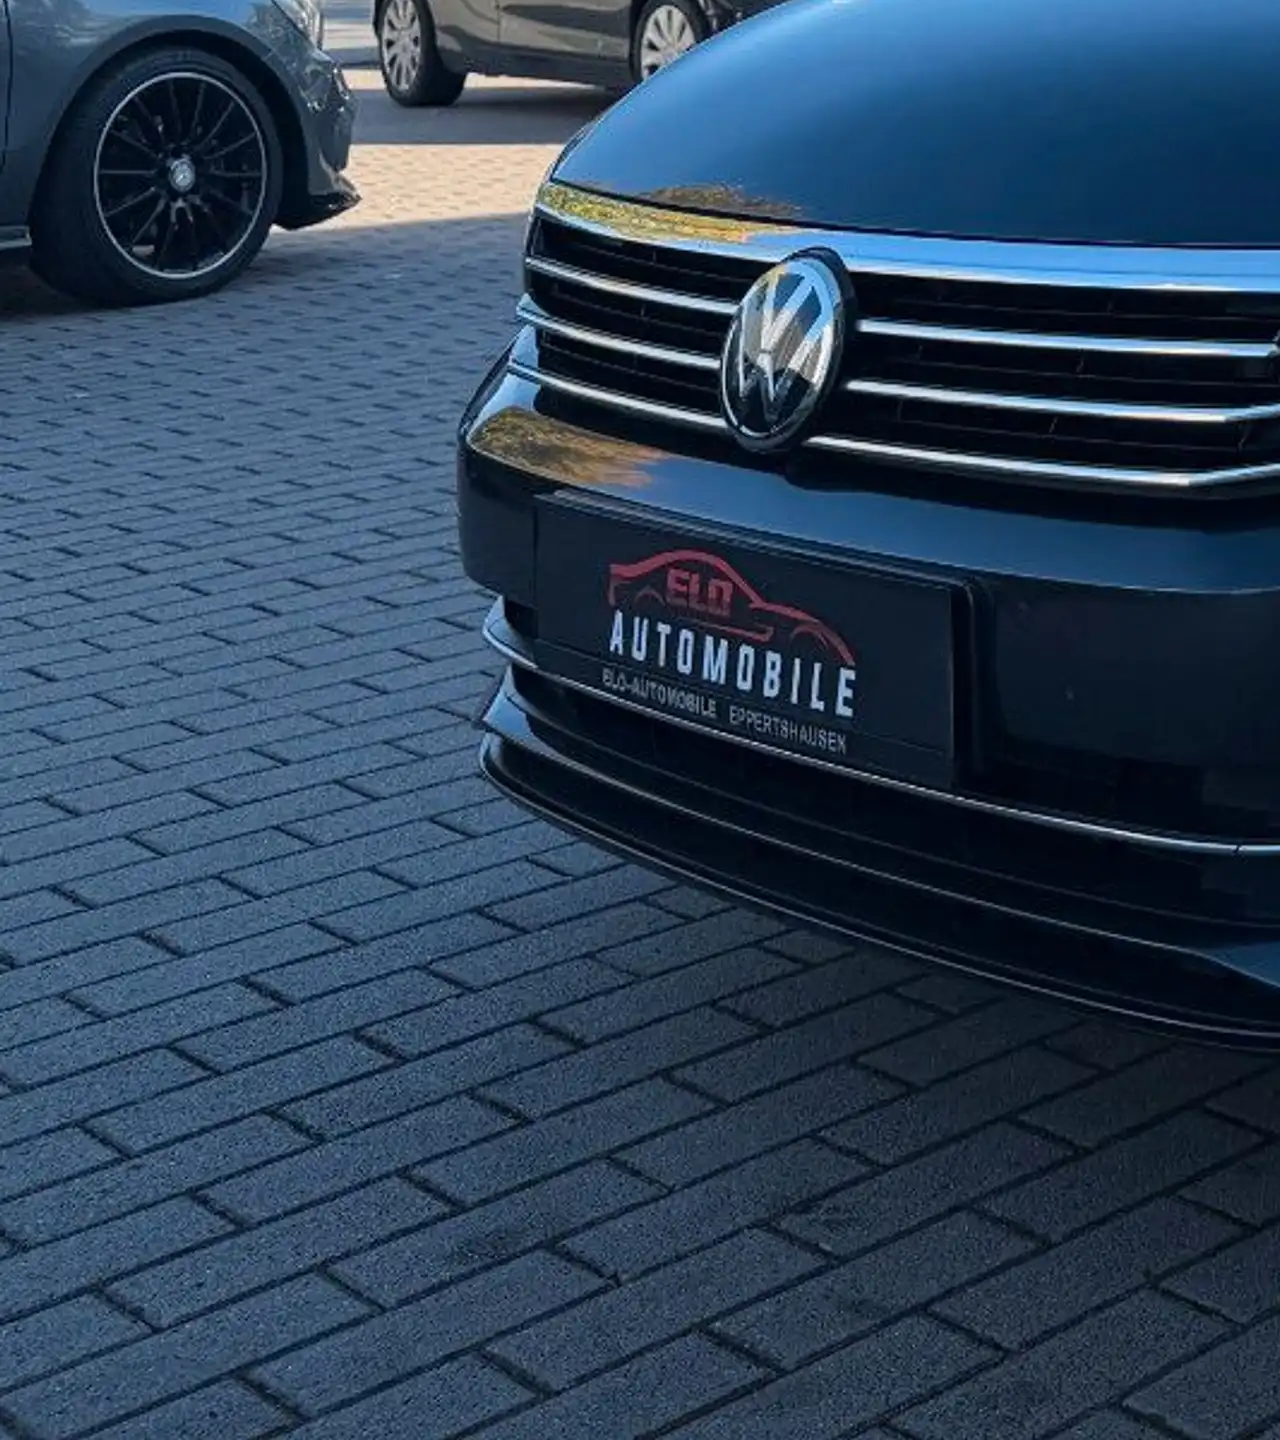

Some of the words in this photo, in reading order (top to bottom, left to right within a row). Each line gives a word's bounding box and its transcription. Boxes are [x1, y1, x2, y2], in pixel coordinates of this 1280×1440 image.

[667, 568, 734, 617] ELO
[609, 610, 857, 717] AUTOMOBILE
[602, 667, 717, 719] ELO-AUTOMOBILE
[728, 705, 847, 754] EPPERTSHAUSEN
